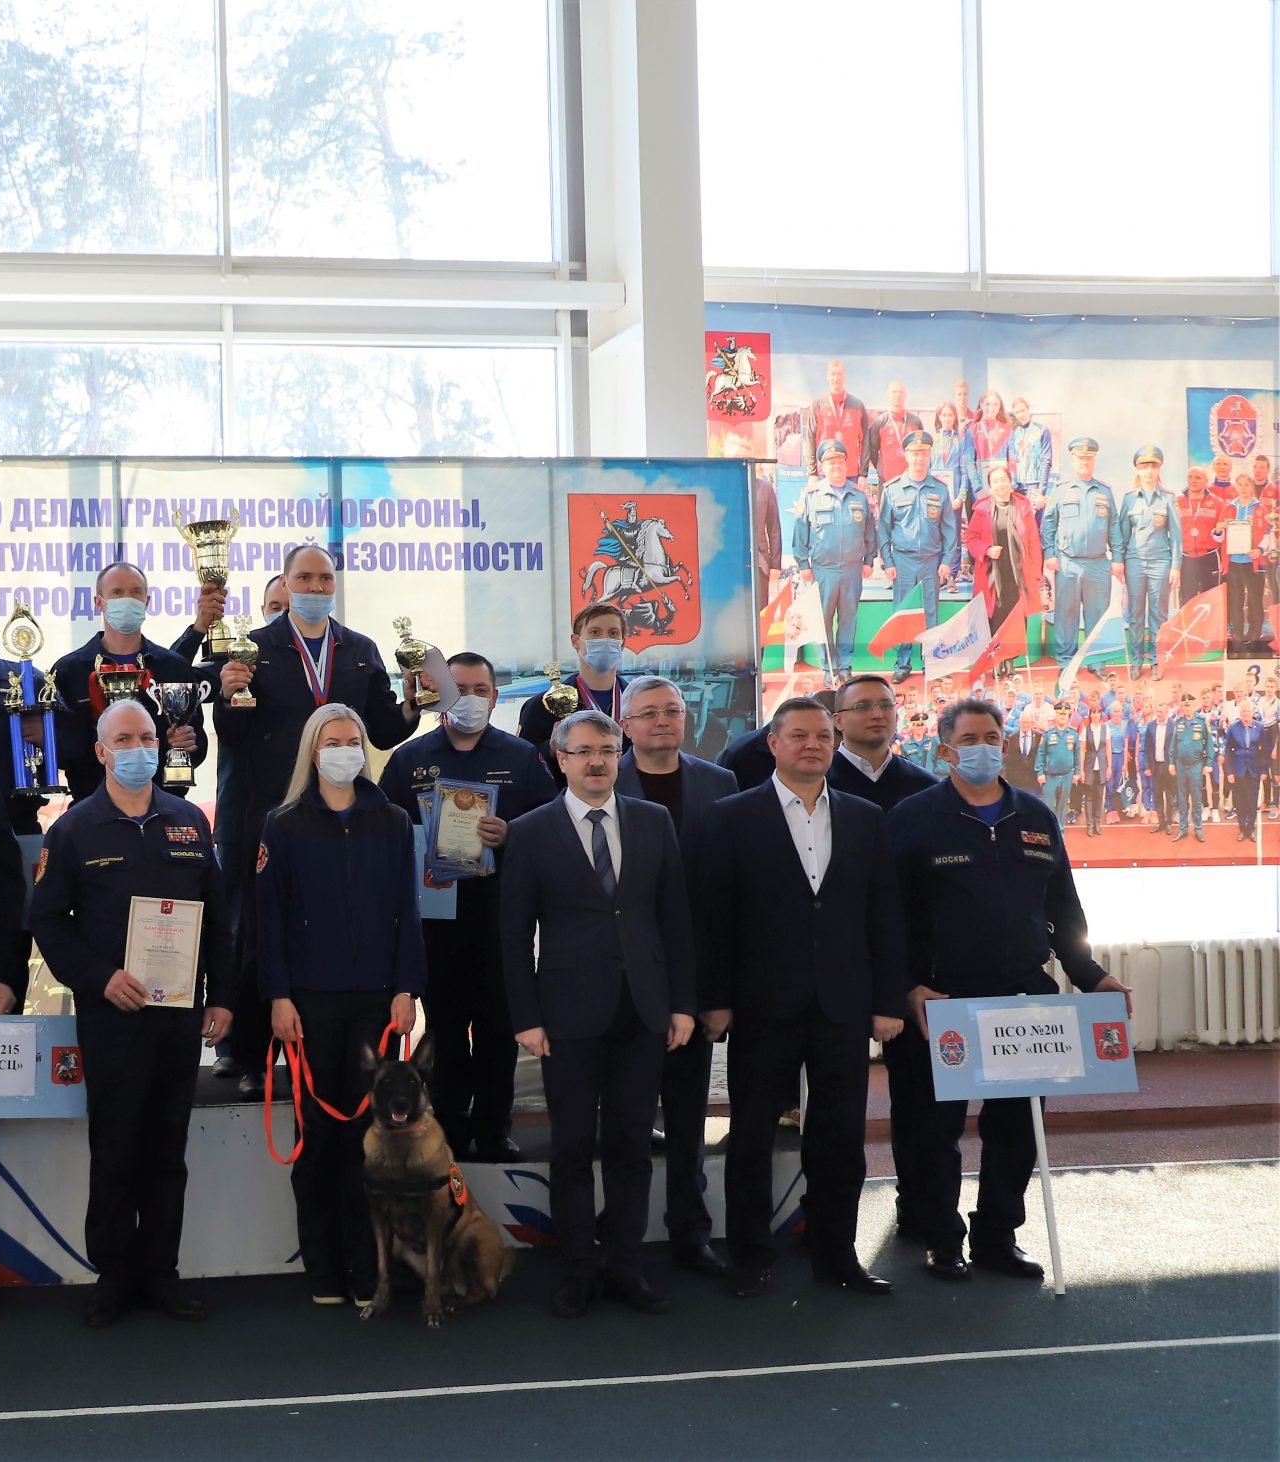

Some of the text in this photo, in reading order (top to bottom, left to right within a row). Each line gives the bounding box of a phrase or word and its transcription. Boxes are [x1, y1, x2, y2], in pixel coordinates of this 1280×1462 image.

[10, 498, 112, 532] ДЕЛАМ
[120, 492, 333, 529] ГРАЖДАНСКОЙ
[340, 498, 487, 531] ОБОРОНЫ,
[137, 542, 154, 572] И
[163, 536, 319, 572] ПОАРН
[327, 542, 543, 572] БЕЗОПАСНОСТИ
[146, 586, 251, 617] ОСКЫ
[935, 855, 970, 865] МОСКВА
[994, 1024, 1065, 1038] ПСО №201
[992, 1041, 1072, 1056] ГКУ «ПСЦ»
